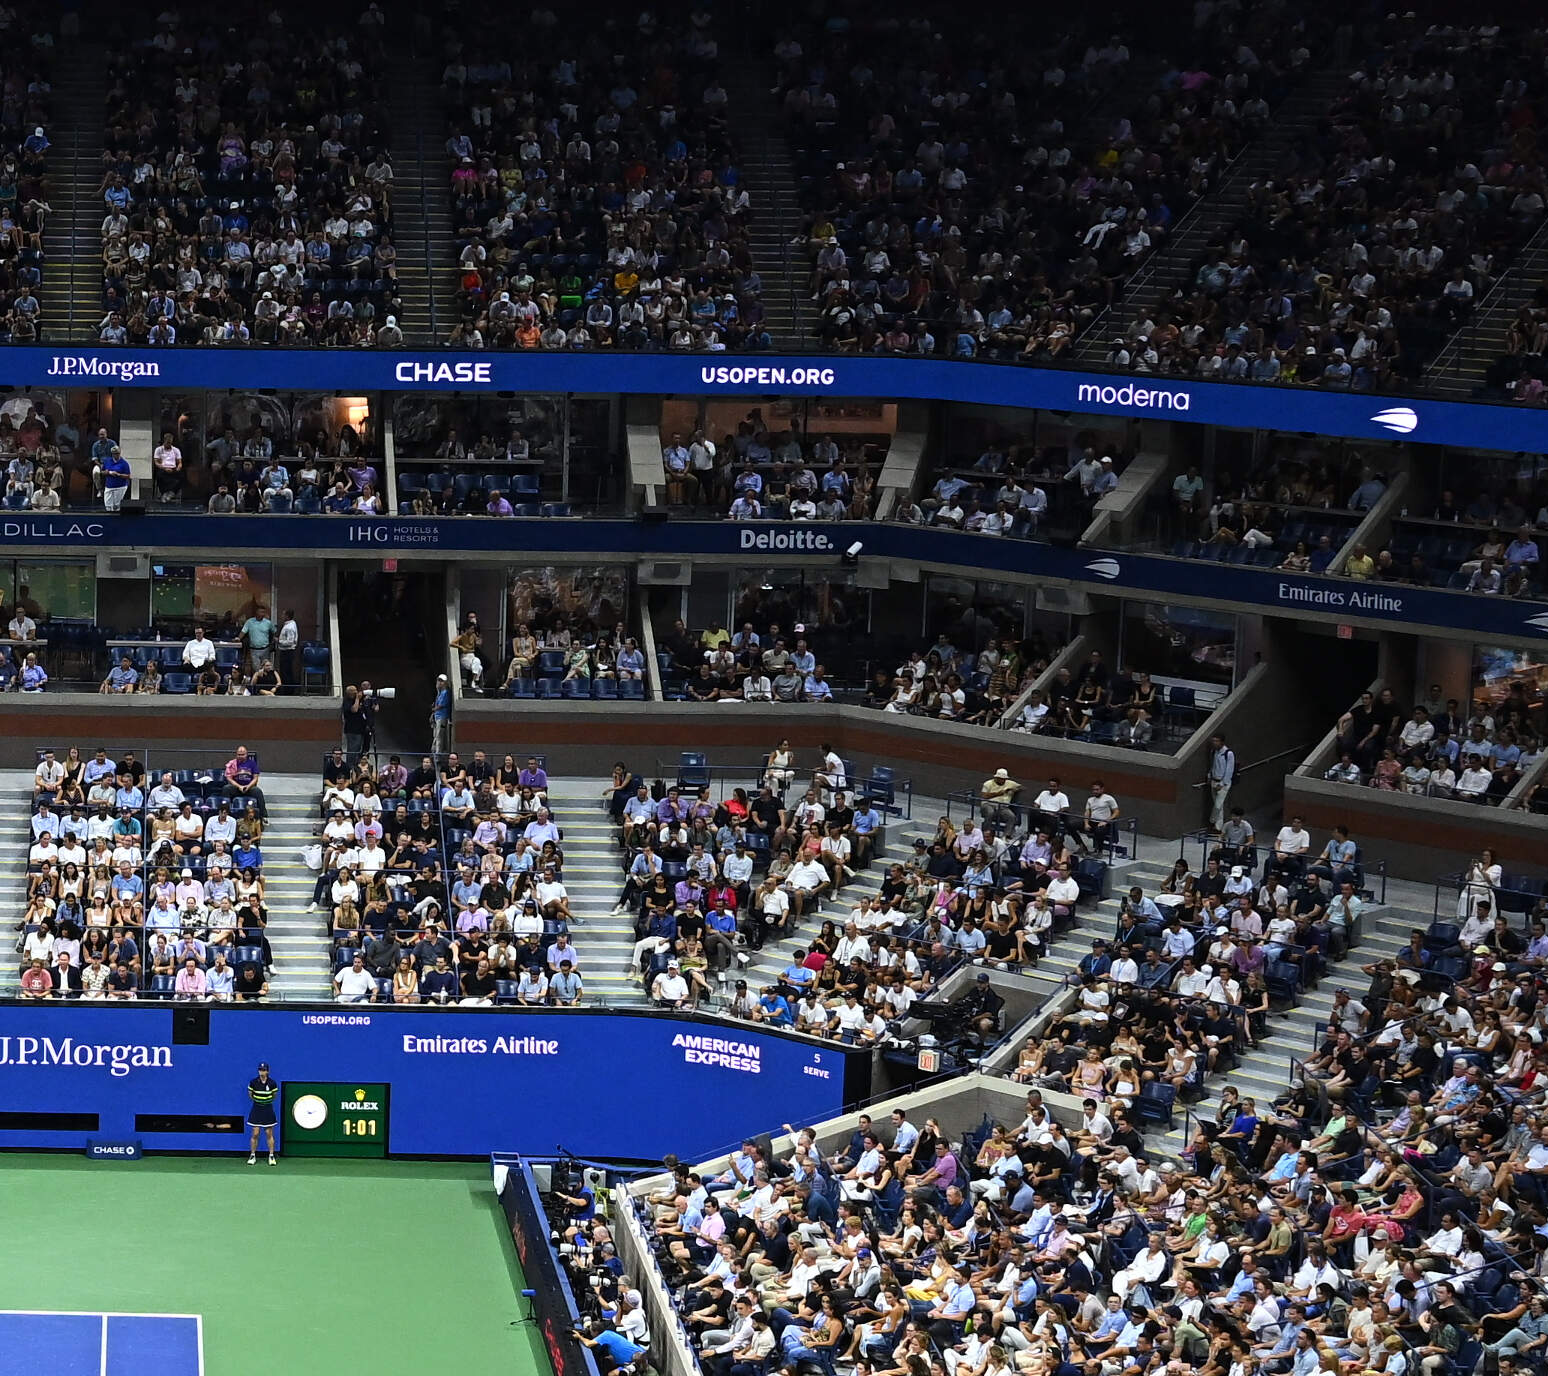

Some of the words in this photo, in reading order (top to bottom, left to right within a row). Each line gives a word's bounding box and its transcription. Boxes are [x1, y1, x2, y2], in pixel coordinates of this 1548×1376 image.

[47, 356, 161, 382] J.P.Morgan
[395, 362, 492, 383] CHASE
[701, 366, 835, 385] USOPEN.ORG
[1078, 383, 1190, 411] moderna
[349, 526, 388, 542] IHG
[393, 526, 430, 534] HOTELS
[431, 526, 440, 534] &
[393, 535, 440, 543] RESORTS
[740, 529, 834, 550] Deloitte.
[1278, 582, 1345, 606] Emirates
[1349, 589, 1403, 613] Airline
[302, 1015, 371, 1026] USOPEN.ORG
[402, 1034, 488, 1054] Emirates
[492, 1035, 559, 1055] Airline
[672, 1033, 761, 1059] AMERICAN
[685, 1050, 761, 1074] EXPRESS
[813, 1053, 821, 1064] 5
[803, 1065, 830, 1079] SERVE
[340, 1101, 379, 1111] ROLEX
[342, 1119, 376, 1136] 1:01
[93, 1146, 125, 1155] CHASE
